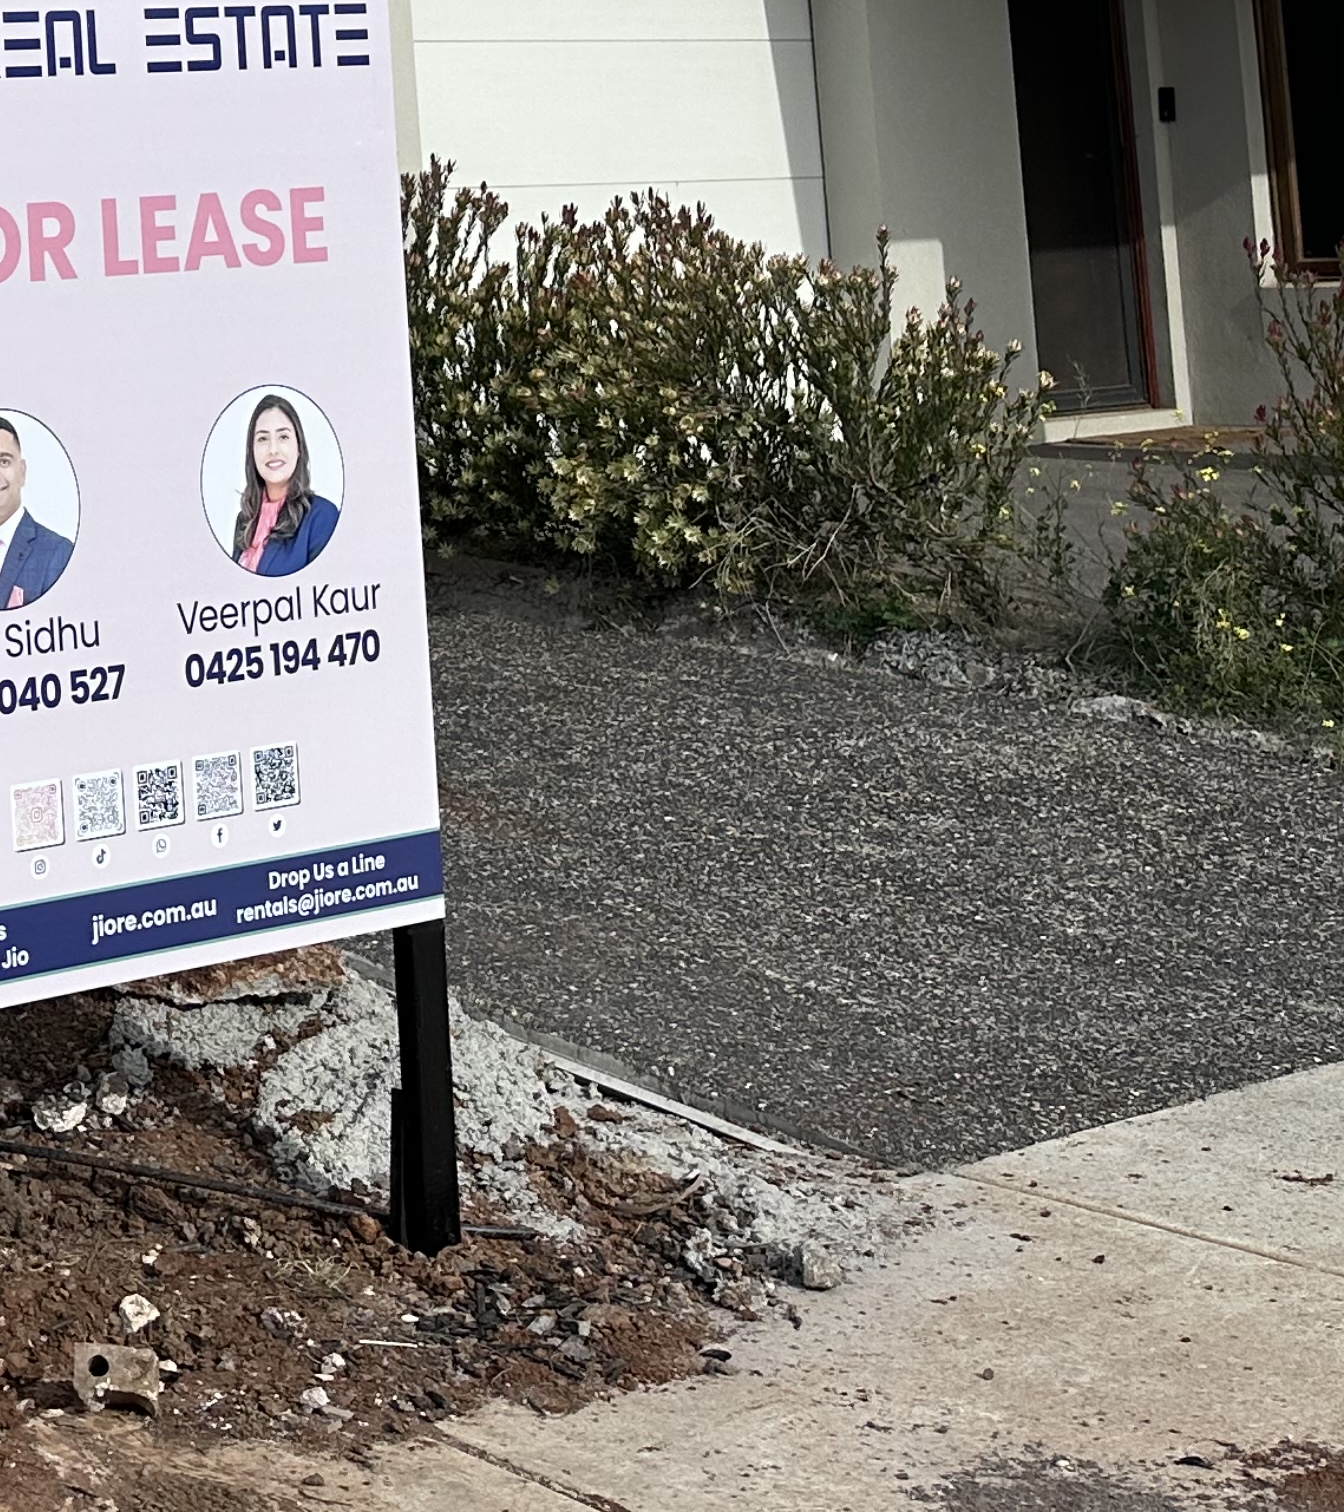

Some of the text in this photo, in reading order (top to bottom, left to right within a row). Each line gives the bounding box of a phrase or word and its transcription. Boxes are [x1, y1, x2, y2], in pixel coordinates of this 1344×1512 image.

[144, 3, 369, 73] ESTATE
[101, 186, 328, 277] LEASE
[177, 583, 381, 638] Veerpal Kaur
[5, 615, 101, 659] Sidhu
[185, 629, 380, 688] 0425 194 470
[70, 664, 125, 704] 527
[268, 852, 386, 891] Drop Us a Line
[91, 898, 217, 945] jiore.com.au
[236, 873, 419, 924] rentals@jiore.com.au
[1, 946, 30, 969] Jio
